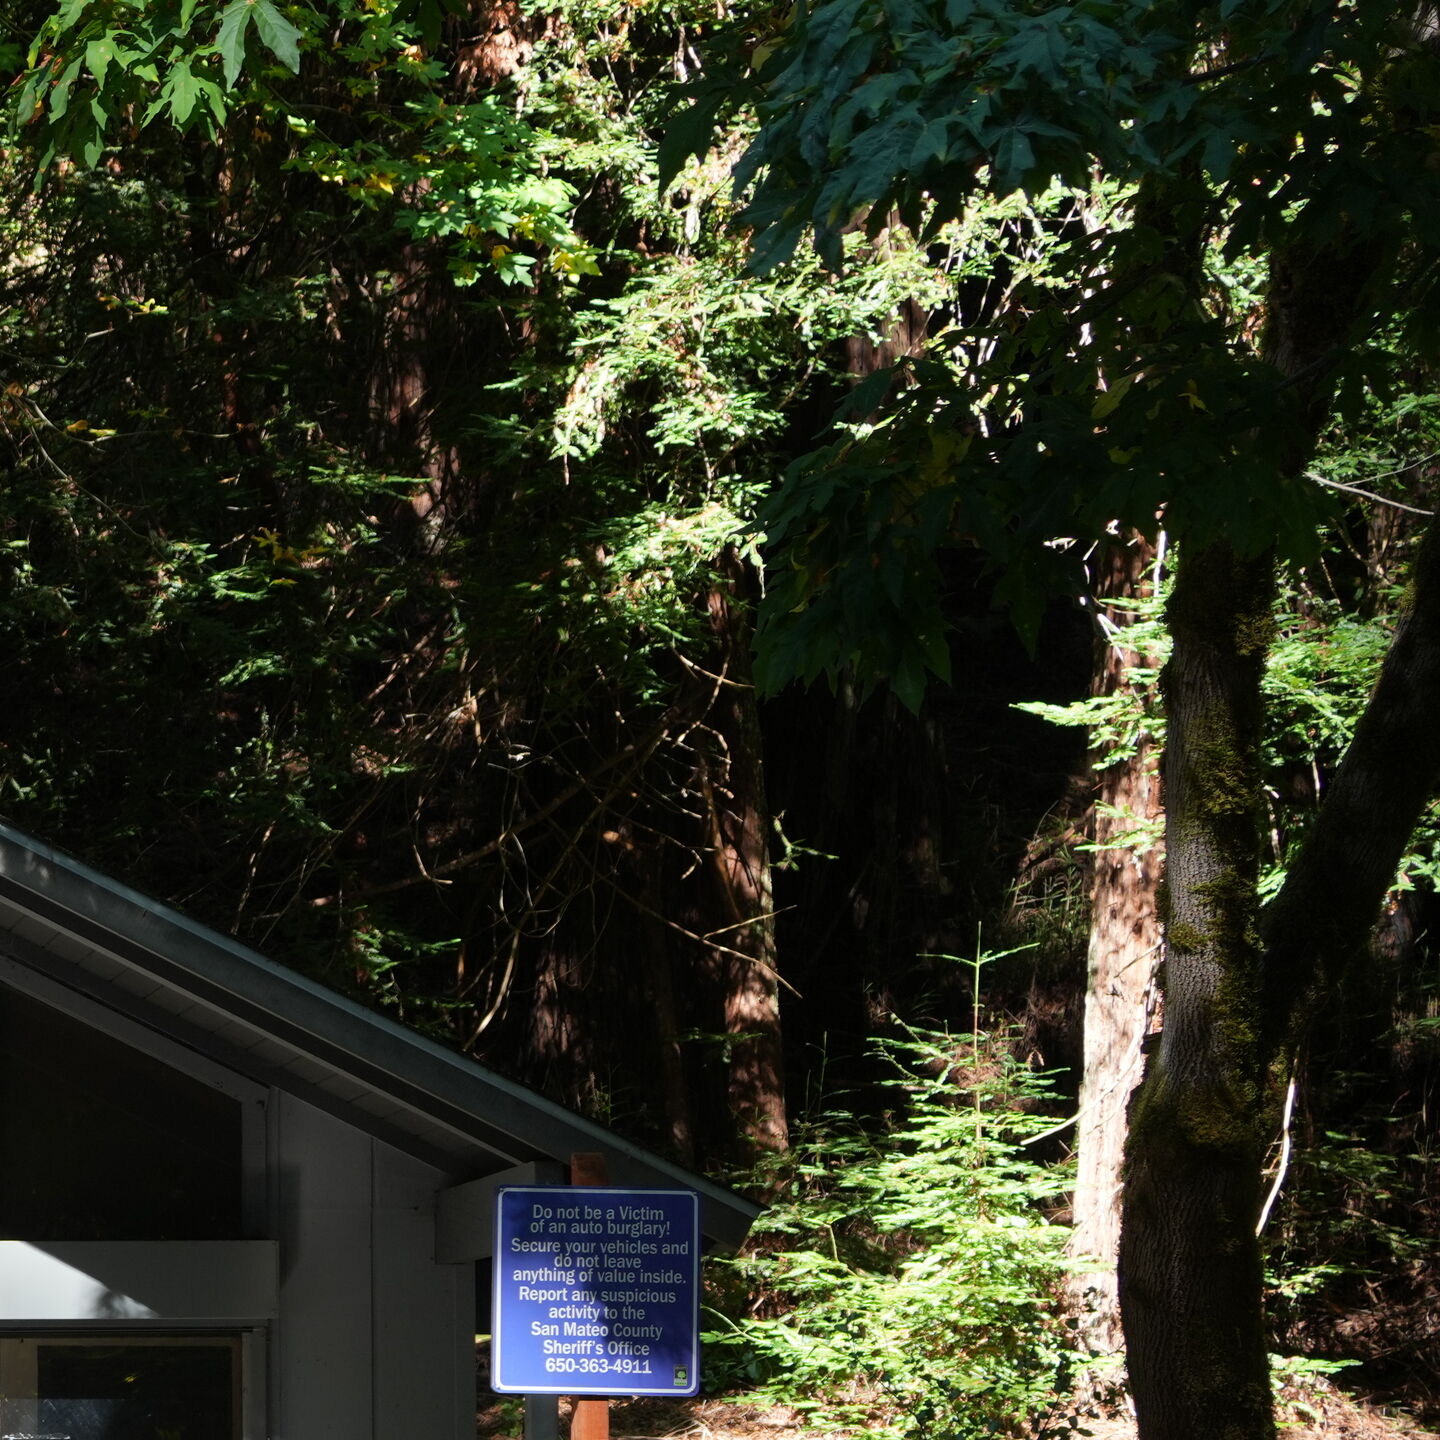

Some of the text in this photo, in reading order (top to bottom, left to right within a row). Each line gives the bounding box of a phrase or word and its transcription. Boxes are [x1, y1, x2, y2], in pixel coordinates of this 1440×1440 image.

[532, 1204, 664, 1220] Do not be a Victim
[530, 1219, 670, 1238] of an auto burglary!
[511, 1238, 688, 1257] Secure your vehicles and
[554, 1254, 641, 1268] do not leave
[513, 1268, 686, 1285] anything of value inside.
[519, 1286, 676, 1305] Report any suspicious
[549, 1305, 645, 1322] activity to the
[531, 1322, 663, 1341] San Mateo County
[543, 1339, 650, 1356] Sheriff's Office
[545, 1357, 652, 1374] 650-363-4911
